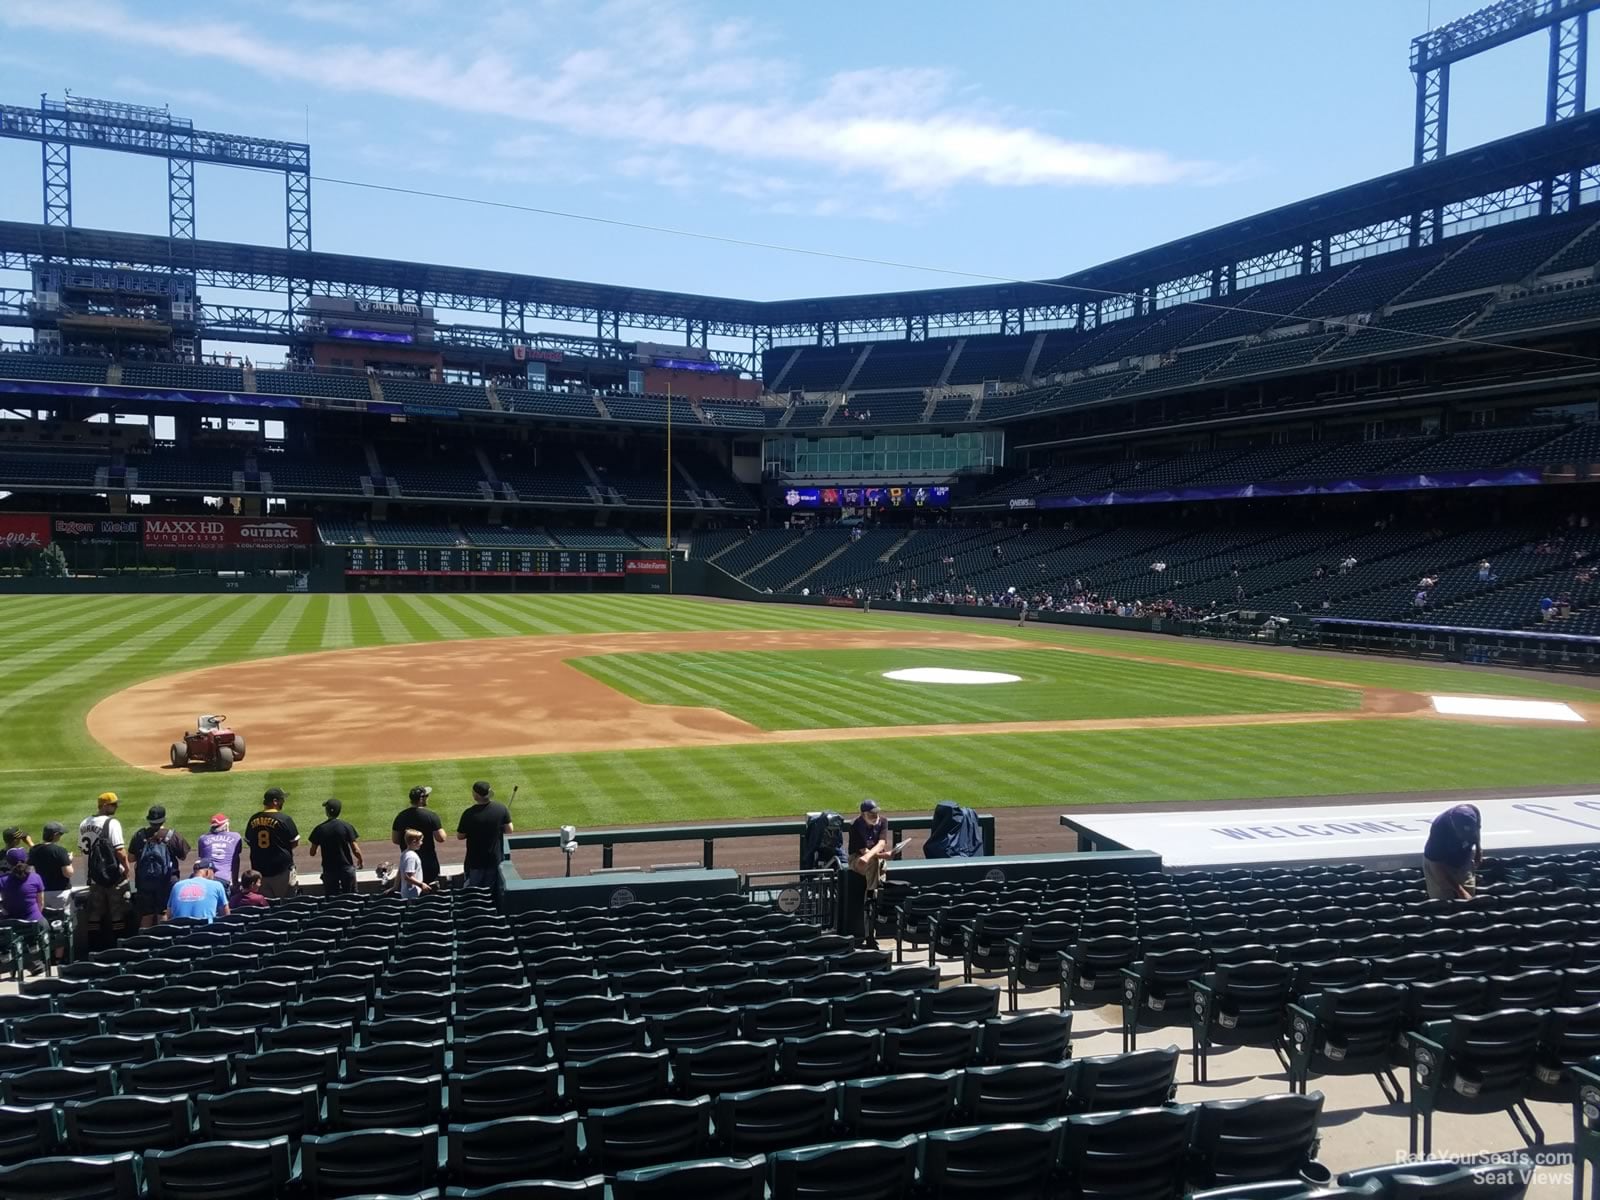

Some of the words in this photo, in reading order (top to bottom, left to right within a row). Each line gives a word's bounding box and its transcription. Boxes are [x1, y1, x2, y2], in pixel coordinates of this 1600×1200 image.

[56, 521, 94, 535] Exxon
[102, 521, 138, 533] Mobil
[145, 521, 197, 533] MAXX
[200, 522, 224, 534] HD
[241, 529, 298, 538] OUTBACK
[146, 534, 224, 542] sunglasses
[1211, 821, 1420, 841] WELCOME
[204, 835, 235, 846] GONZALEZ
[258, 831, 270, 849] 8
[212, 843, 227, 860] 5
